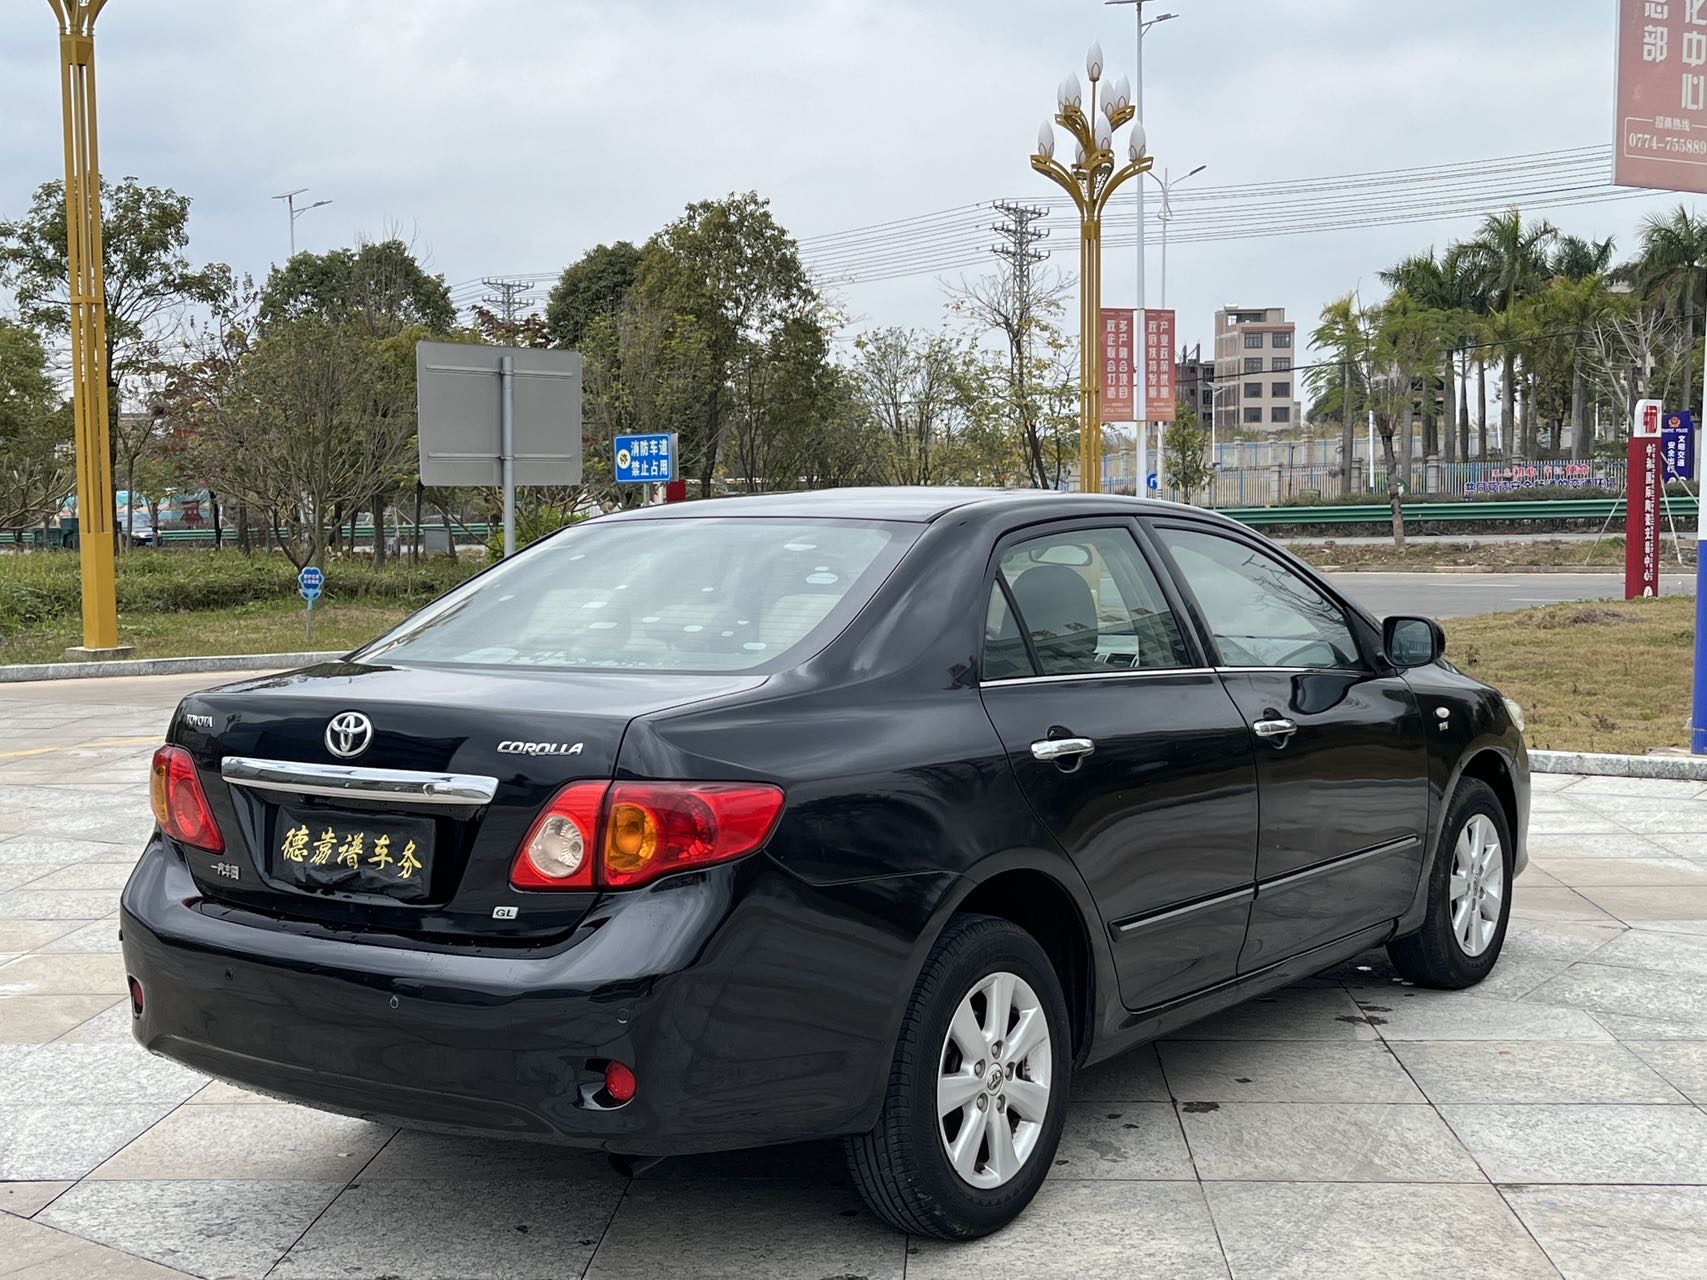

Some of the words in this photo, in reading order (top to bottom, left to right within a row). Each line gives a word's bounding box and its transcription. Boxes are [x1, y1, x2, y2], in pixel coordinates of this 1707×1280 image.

[1628, 132, 1707, 155] 0774-755889
[630, 439, 668, 457] 消防车道
[631, 459, 668, 477] 禁止占用
[186, 713, 213, 728] TOYOTA
[496, 740, 584, 757] COROLLA
[210, 861, 240, 880] 一汽丰田
[494, 907, 516, 919] GL
